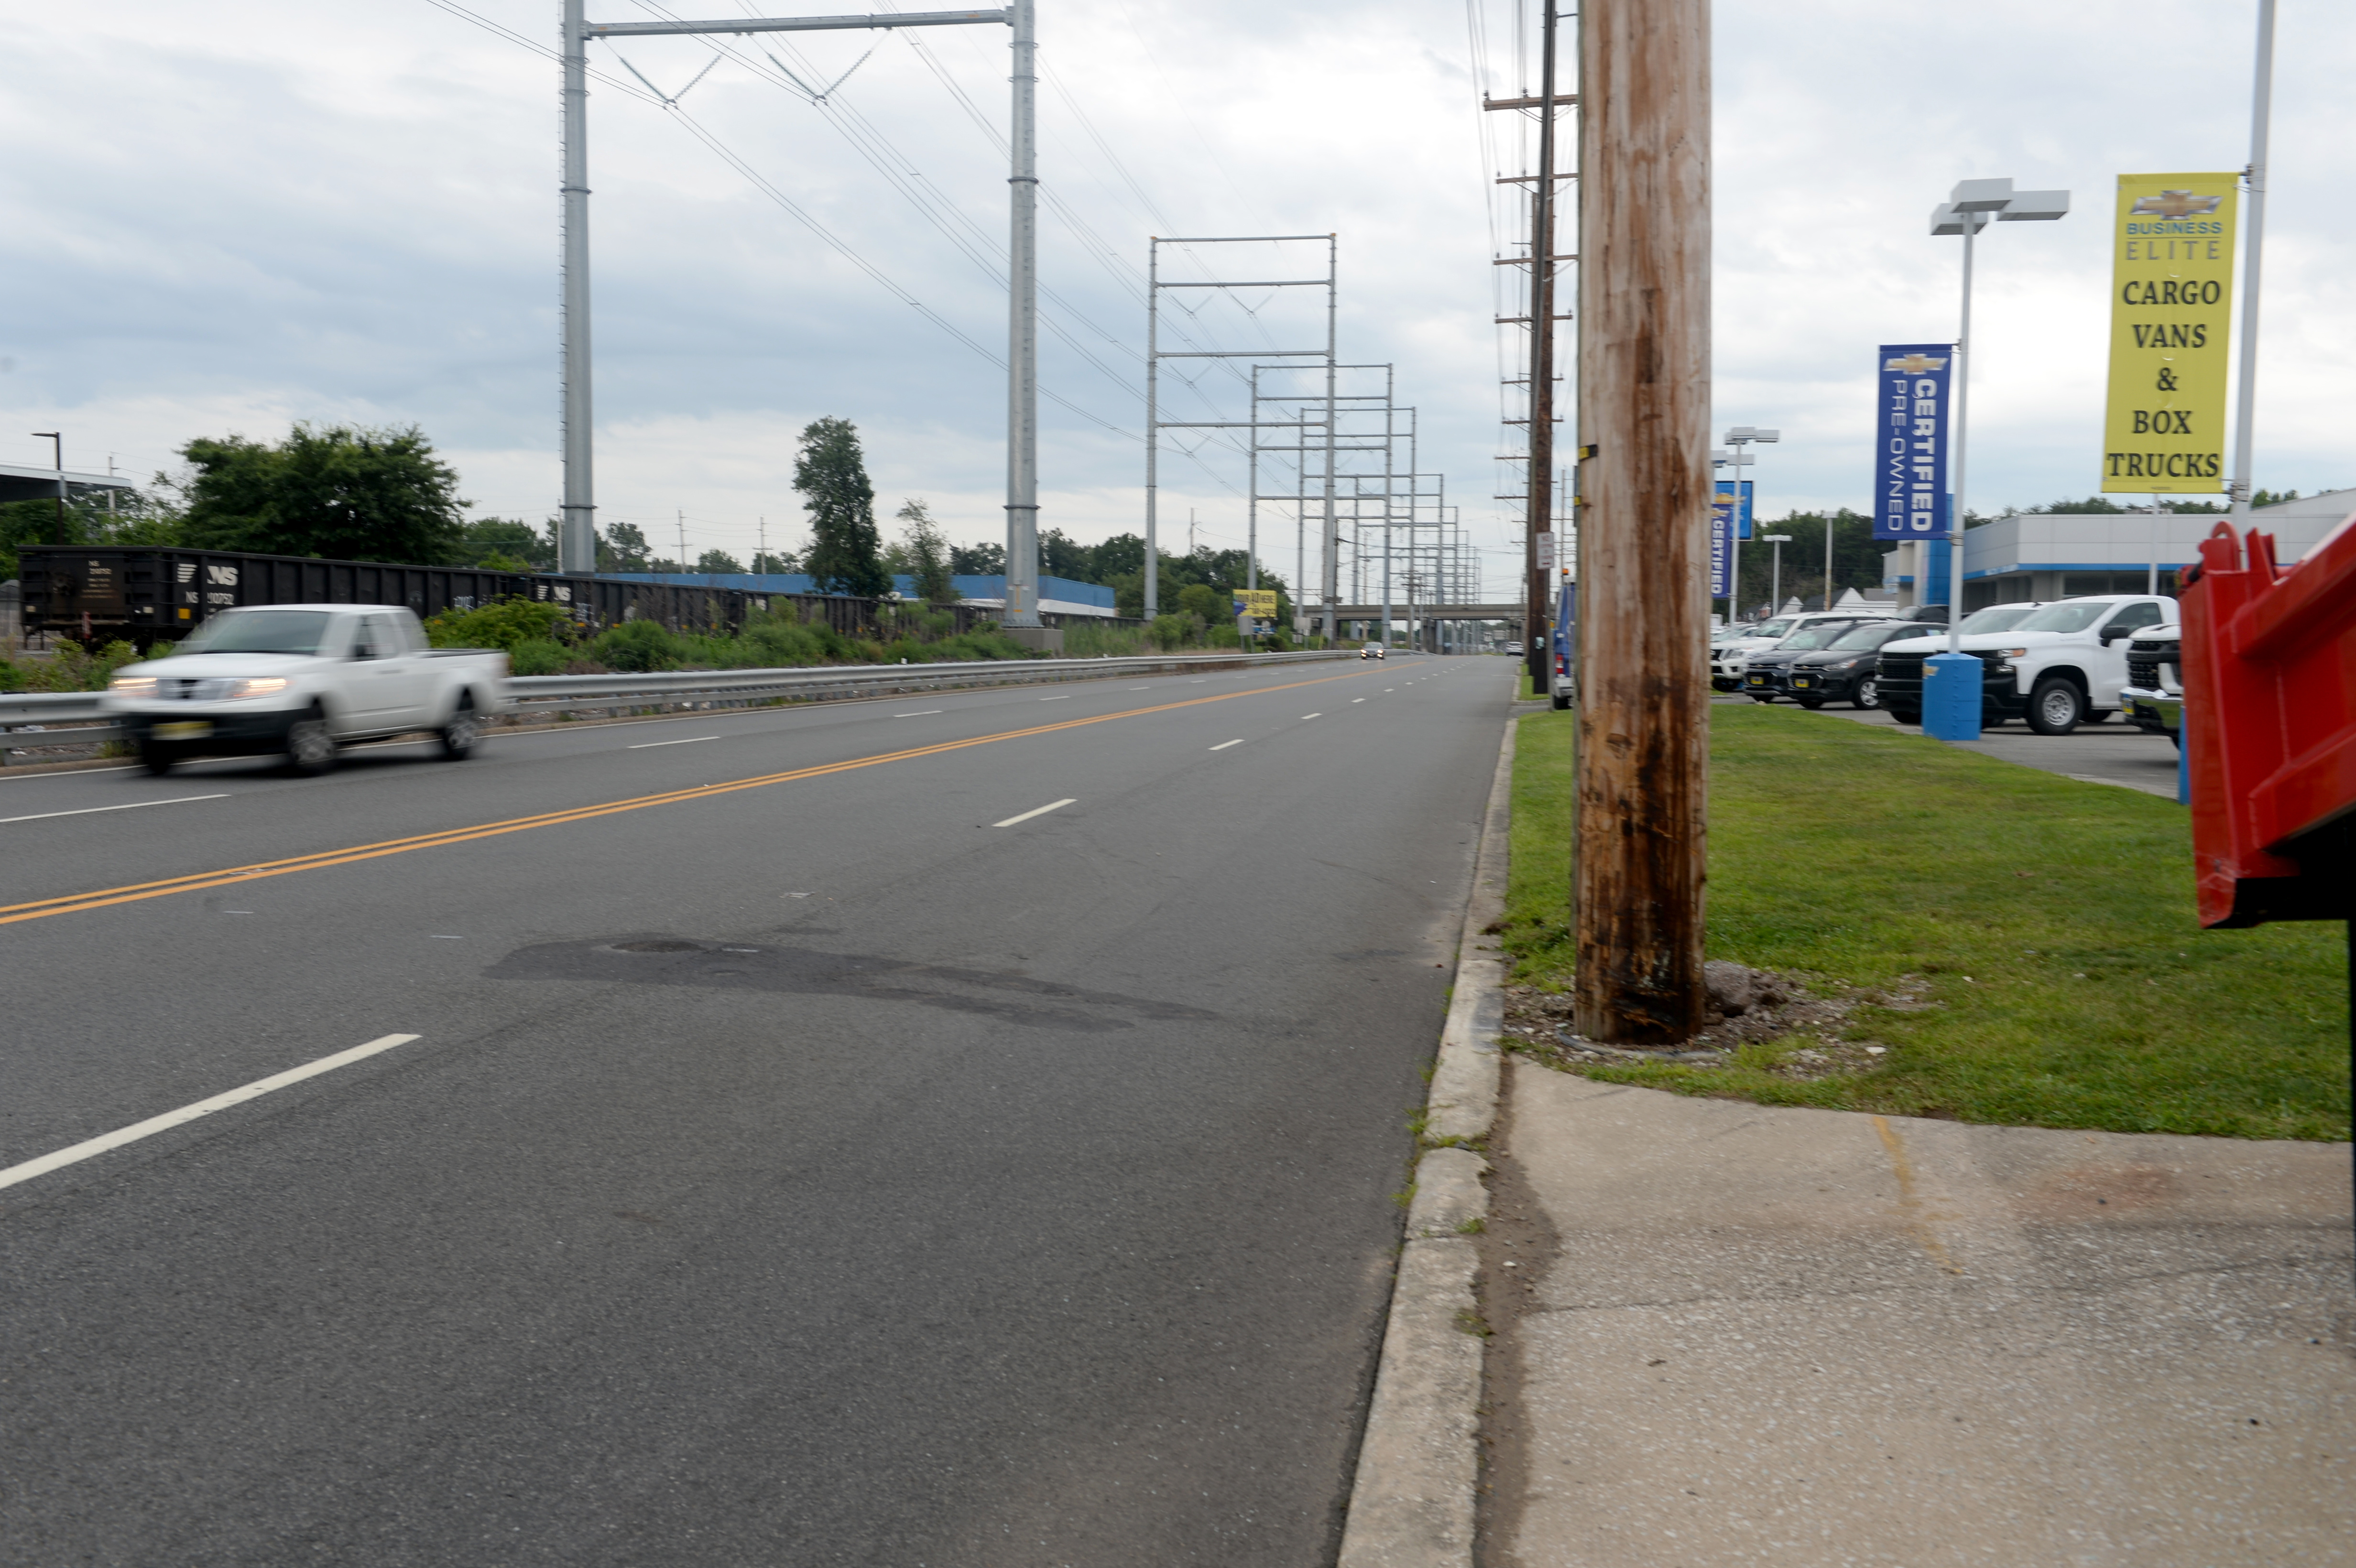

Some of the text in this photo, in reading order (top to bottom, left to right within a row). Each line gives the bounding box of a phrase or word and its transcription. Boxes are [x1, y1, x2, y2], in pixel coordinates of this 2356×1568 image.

[2126, 222, 2223, 235] BUSINESS
[2126, 240, 2221, 260] ELITE
[2123, 280, 2221, 305] CARGO
[2132, 323, 2207, 348] VANS
[2156, 367, 2179, 392] &
[2132, 410, 2193, 435] BOX
[1887, 380, 1908, 531] PRE-OWNED
[1910, 378, 1938, 532] CERTIFIED
[2106, 453, 2220, 478] TRUCKS
[1711, 520, 1725, 594] CERTIFIED
[207, 566, 239, 586] NS
[185, 591, 199, 603] NS
[551, 586, 572, 601] NS
